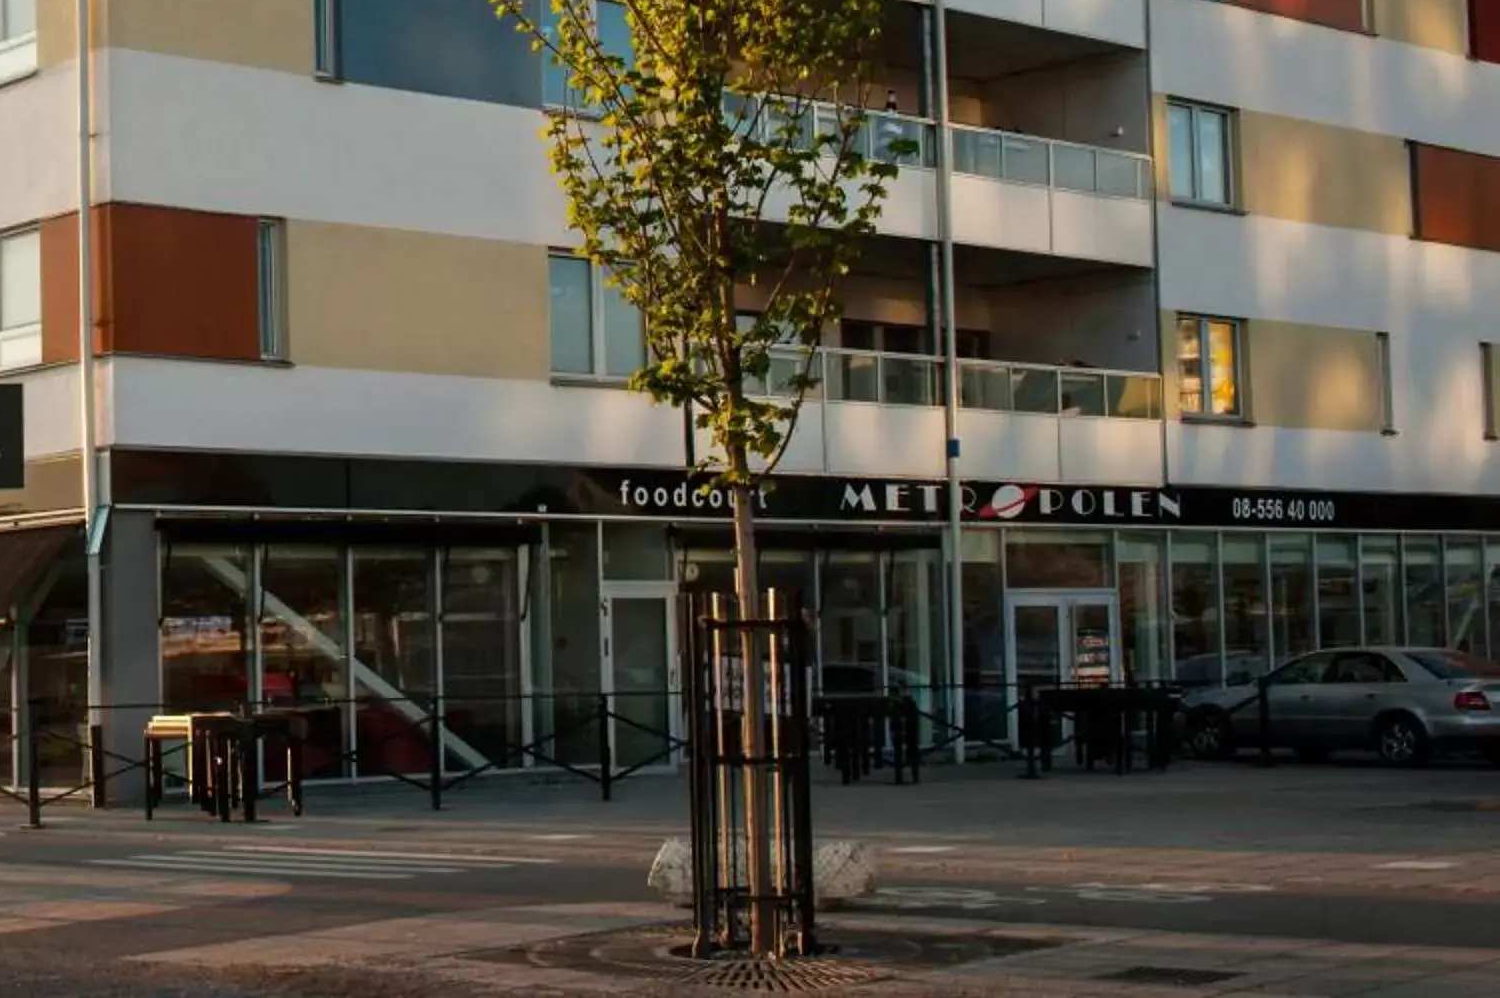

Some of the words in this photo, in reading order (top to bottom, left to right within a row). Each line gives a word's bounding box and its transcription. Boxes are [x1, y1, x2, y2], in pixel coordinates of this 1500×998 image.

[1232, 496, 1284, 520] 08-556
[1287, 499, 1305, 521] 40
[1308, 500, 1335, 521] 000
